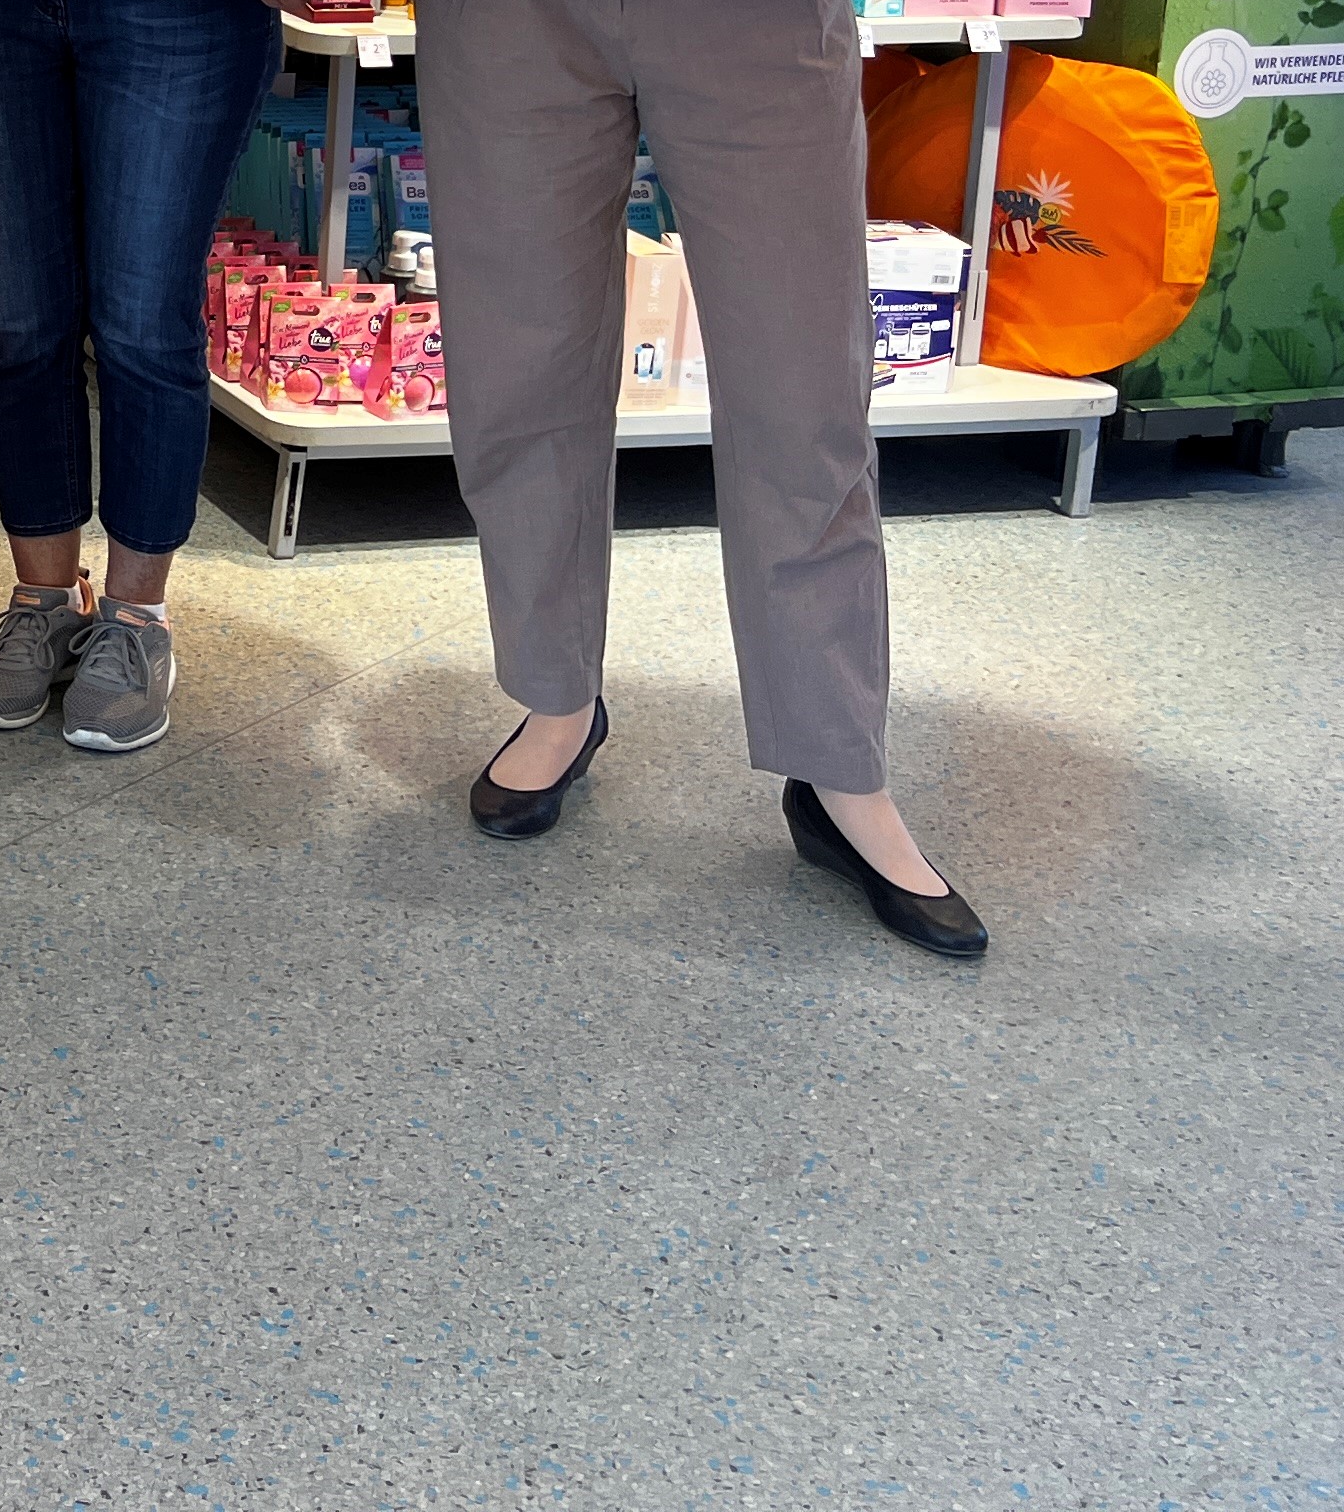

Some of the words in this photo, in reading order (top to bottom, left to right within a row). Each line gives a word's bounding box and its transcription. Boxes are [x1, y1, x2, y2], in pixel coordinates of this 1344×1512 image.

[1254, 57, 1278, 69] WIR
[1252, 71, 1317, 86] NATÜRLICHE
[310, 330, 332, 346] true
